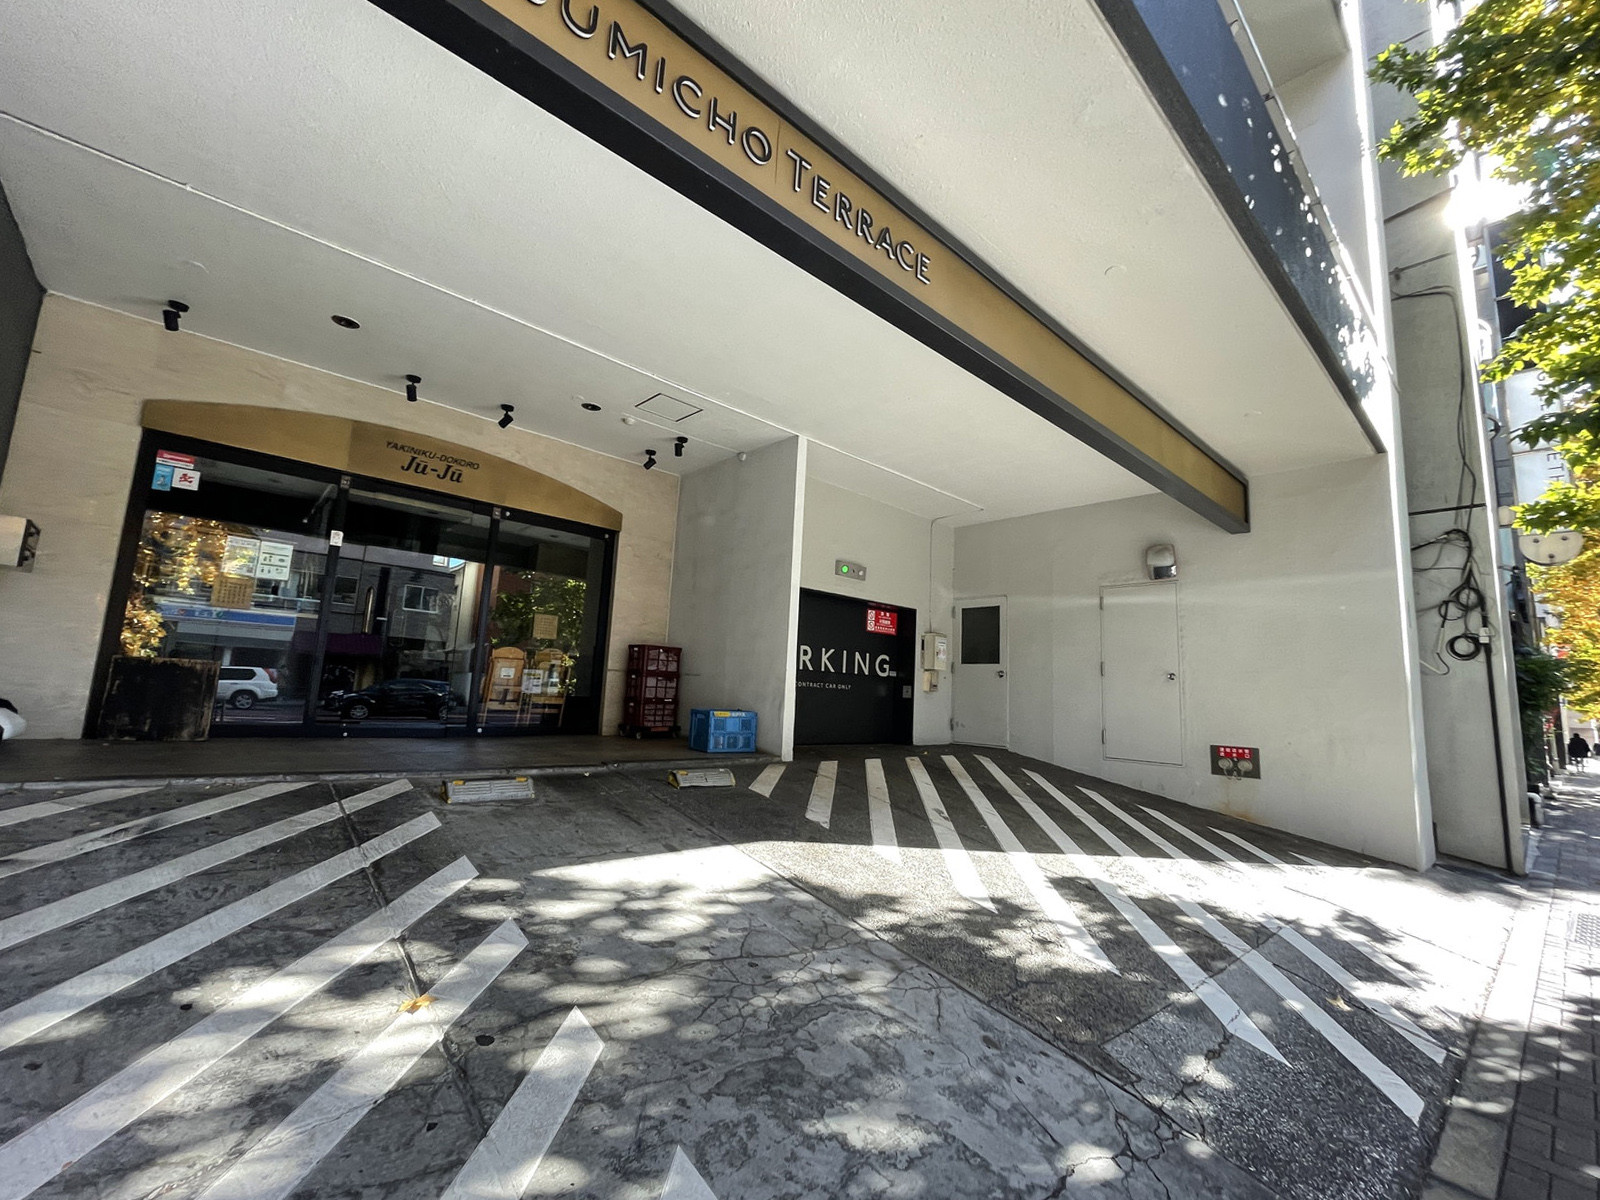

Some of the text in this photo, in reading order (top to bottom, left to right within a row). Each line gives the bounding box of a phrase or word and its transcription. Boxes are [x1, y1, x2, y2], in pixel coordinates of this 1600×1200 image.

[526, 0, 931, 285] UMICHO TERRACE
[385, 440, 480, 470] YAKINIKU-DOKORO
[799, 644, 890, 677] RKING
[796, 681, 824, 689] ONTRACT
